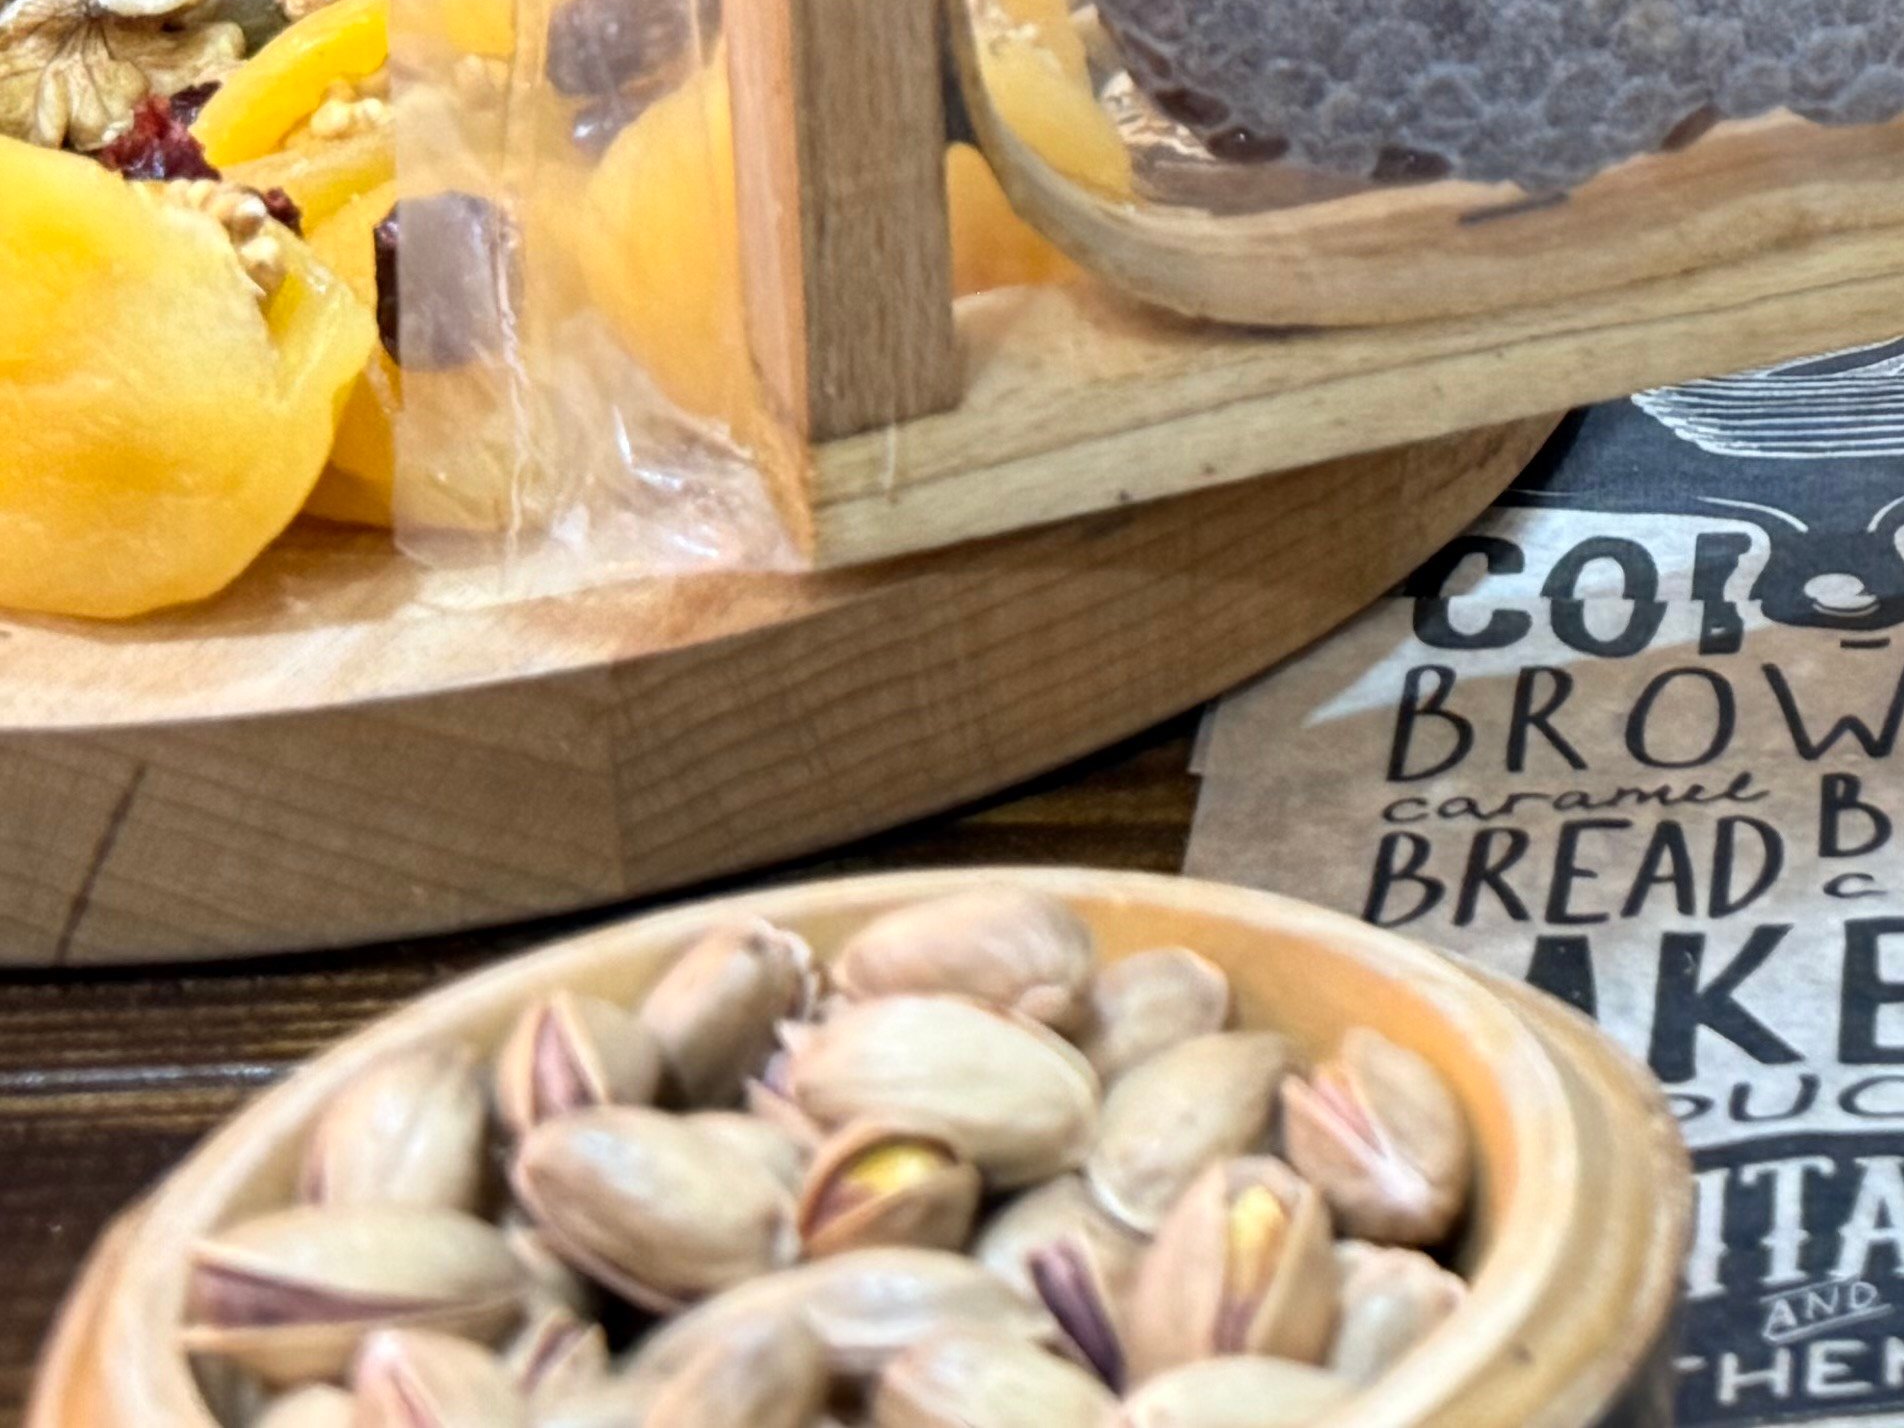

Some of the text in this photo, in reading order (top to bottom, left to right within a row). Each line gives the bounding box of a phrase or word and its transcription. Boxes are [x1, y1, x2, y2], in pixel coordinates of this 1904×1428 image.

[1380, 770, 1772, 824] caramel
[1362, 815, 1785, 928] BREAD
[1764, 1281, 1882, 1329] AND
